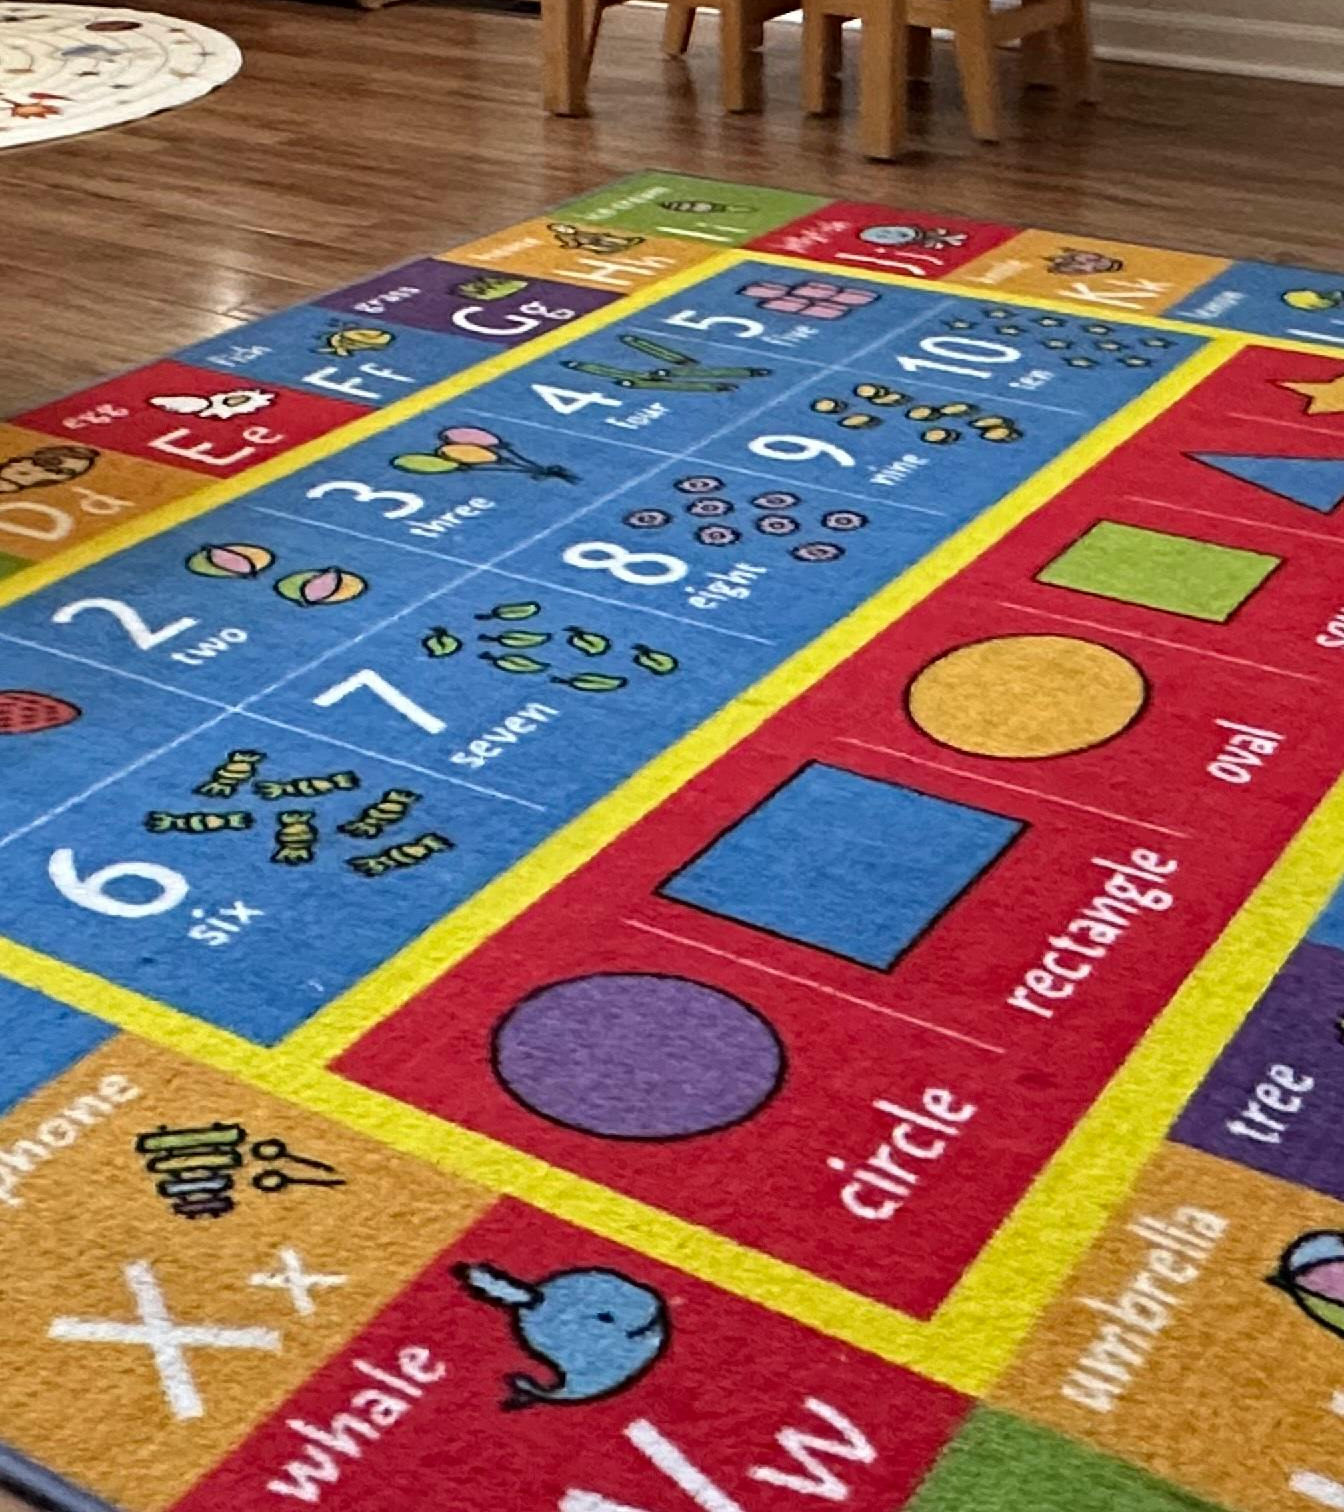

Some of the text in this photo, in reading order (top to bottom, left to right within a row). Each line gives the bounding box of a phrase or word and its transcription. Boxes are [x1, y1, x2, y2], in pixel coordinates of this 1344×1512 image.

[553, 256, 678, 286] Hh
[835, 247, 944, 276] Jj
[1056, 277, 1174, 310] Kk
[452, 300, 575, 336] Gg
[662, 310, 764, 339] 5
[760, 323, 821, 347] five
[896, 335, 1022, 380] 10
[1008, 369, 1056, 390] ten
[302, 362, 416, 399] Ff
[530, 383, 624, 415] 4
[62, 404, 129, 431] egg
[604, 401, 674, 430] four
[147, 425, 285, 466] Ee
[747, 433, 857, 468] 9
[869, 452, 930, 487] nine
[306, 479, 425, 519] 3
[407, 495, 496, 539] three
[561, 539, 691, 587] 8
[686, 558, 769, 612] eight
[53, 596, 201, 651] 2
[170, 624, 249, 668] two
[311, 667, 450, 737] 7
[447, 697, 562, 770] seven
[1206, 718, 1288, 785] oval
[48, 845, 191, 921] 6
[186, 896, 267, 949] six
[1006, 845, 1180, 1020] rectangle
[1228, 1062, 1316, 1146] tree
[837, 1085, 980, 1224] circle
[1062, 1200, 1229, 1413] umbrella
[46, 1246, 348, 1422] Xx
[267, 1342, 447, 1507] whale
